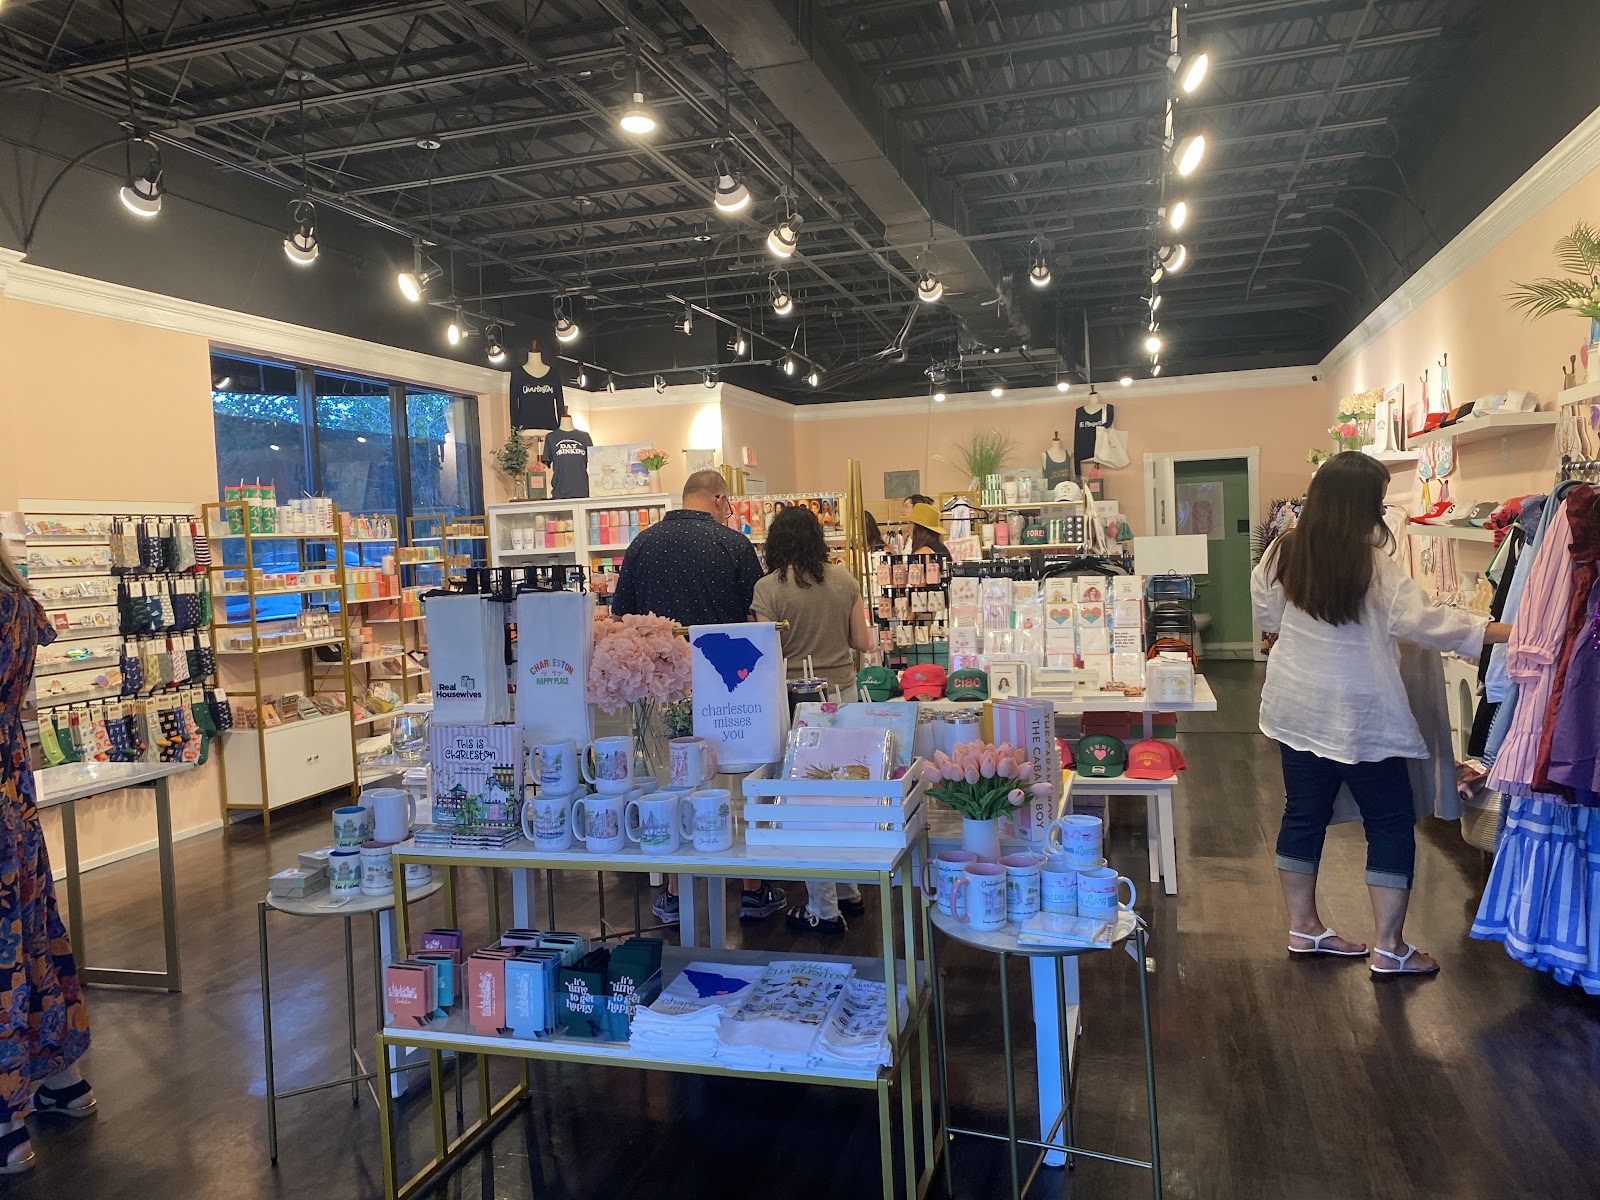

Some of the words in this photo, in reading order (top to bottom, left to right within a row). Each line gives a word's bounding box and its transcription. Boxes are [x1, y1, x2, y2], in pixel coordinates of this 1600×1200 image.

[1470, 507, 1480, 518] S
[1026, 529, 1045, 538] FORE!
[529, 658, 574, 675] CHARLESTON
[439, 683, 456, 691] Real
[536, 677, 553, 685] HAPPY
[553, 677, 570, 685] PLACE
[953, 675, 981, 688] ciao
[436, 690, 482, 698] Housewives
[701, 702, 762, 717] charleston
[714, 716, 752, 728] misses
[722, 729, 745, 743] you
[1031, 718, 1040, 743] THE
[1035, 803, 1044, 829] BOY
[620, 975, 634, 985] it's
[766, 967, 849, 980] CHARLESTON
[564, 981, 588, 995] time
[574, 977, 586, 986] it's
[609, 980, 635, 995] time
[570, 992, 579, 1002] to
[579, 992, 594, 1004] get
[613, 992, 623, 1002] to
[624, 992, 641, 1005] get
[566, 998, 594, 1014] happy
[607, 999, 637, 1016] happy
